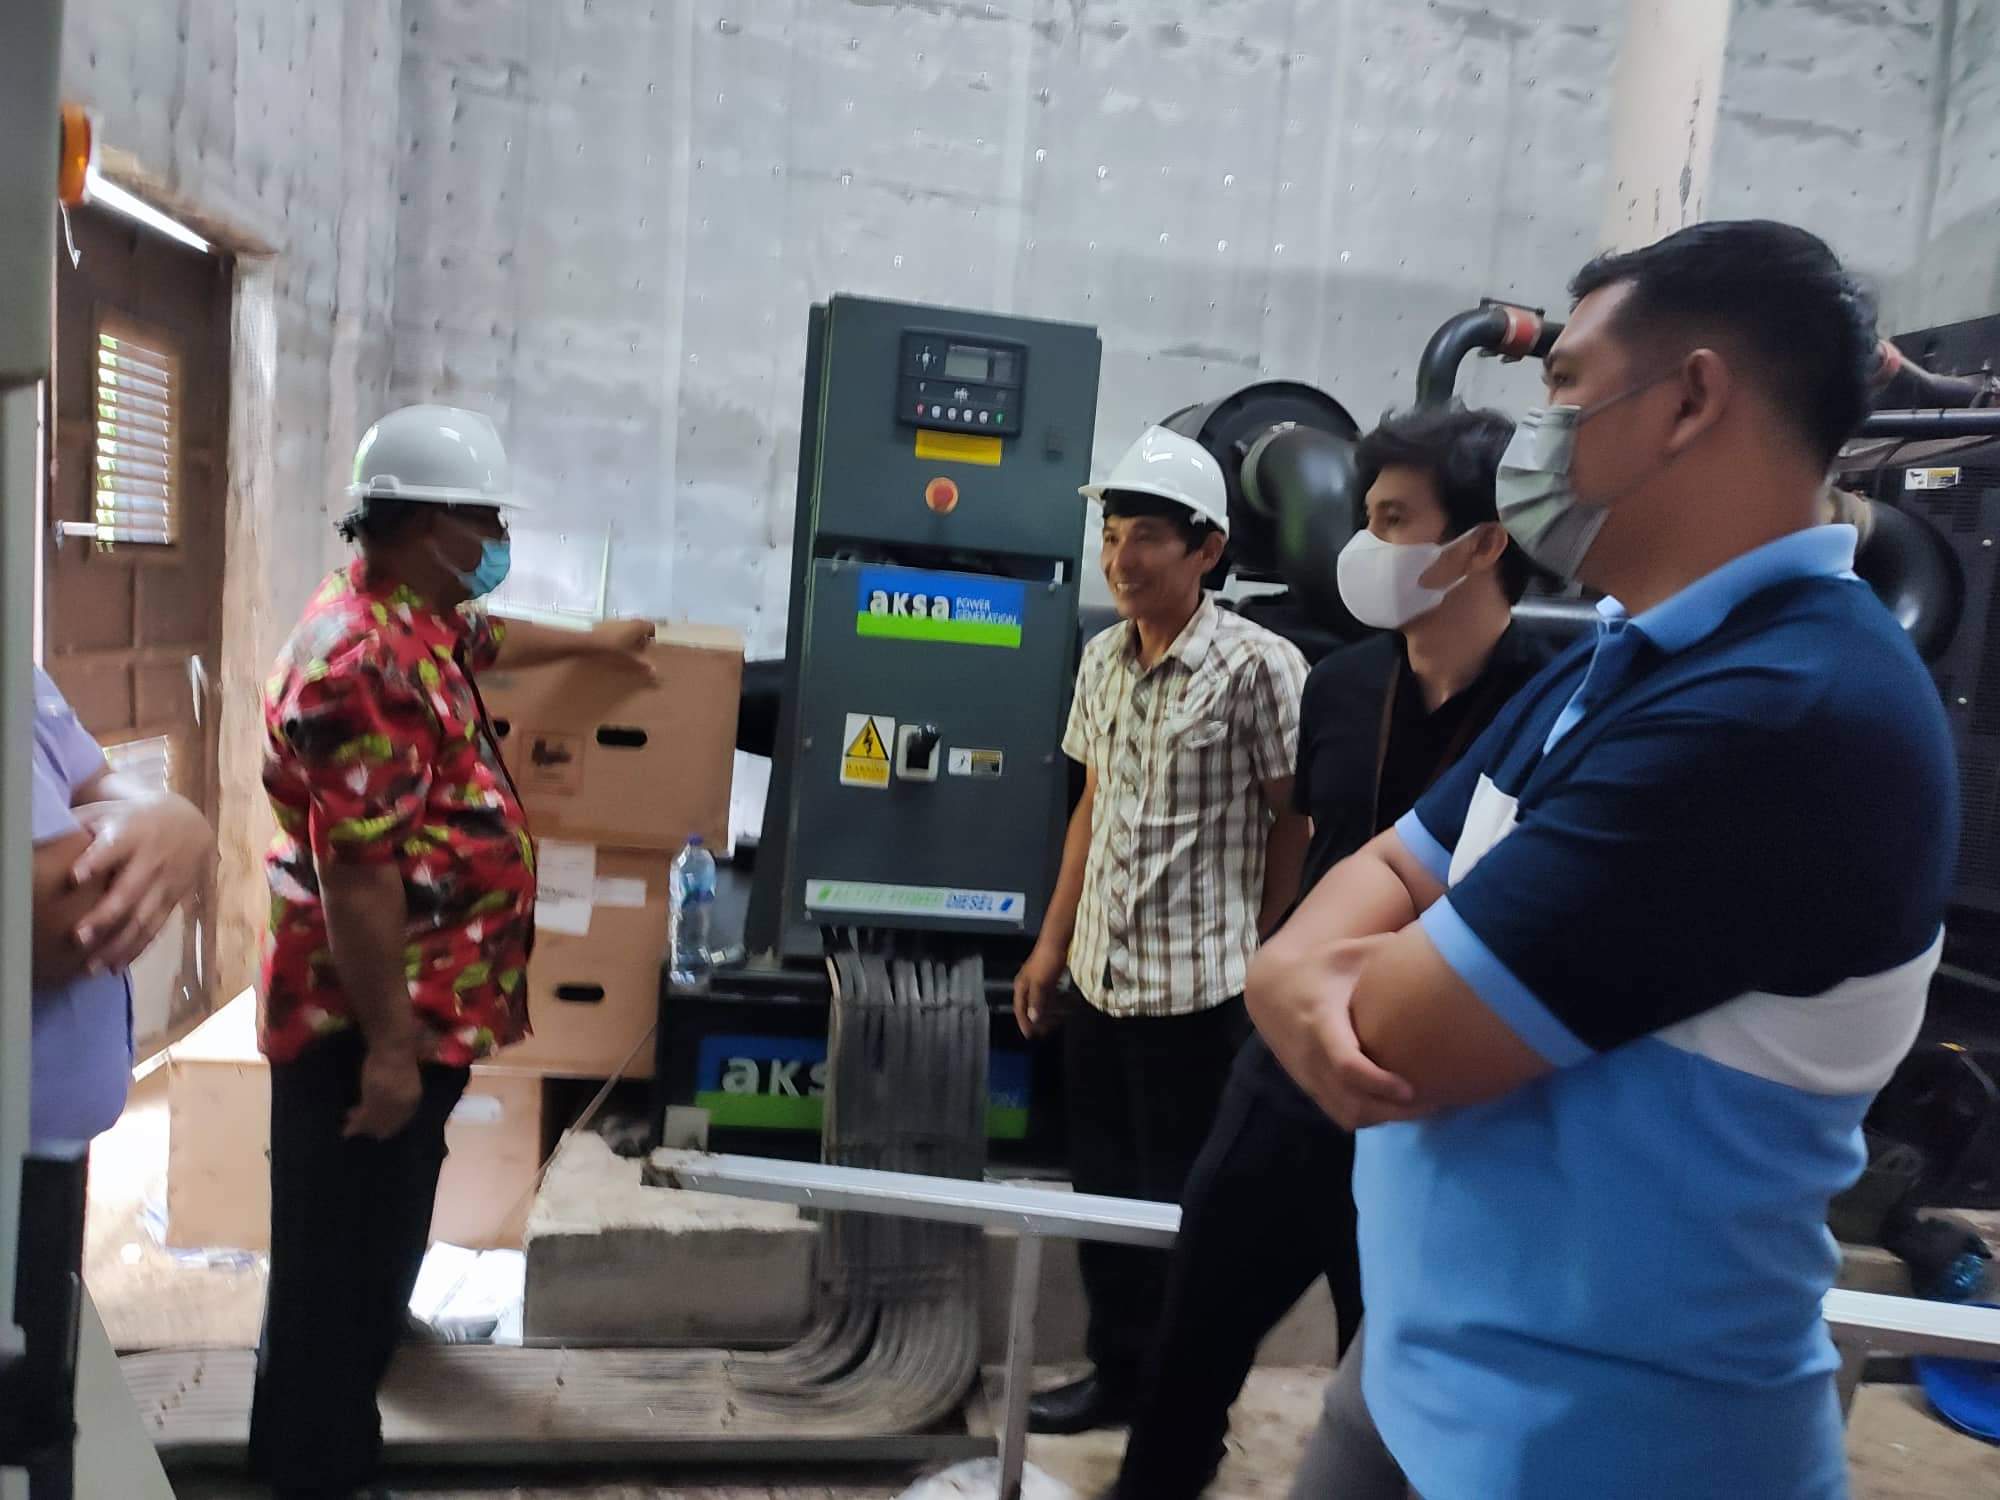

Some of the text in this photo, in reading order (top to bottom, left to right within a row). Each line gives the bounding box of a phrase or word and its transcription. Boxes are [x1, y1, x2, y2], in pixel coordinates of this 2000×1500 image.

[870, 590, 949, 623] aksa
[955, 597, 991, 610] POWER
[955, 609, 1017, 626] GENERATION
[722, 1057, 828, 1097] aks
